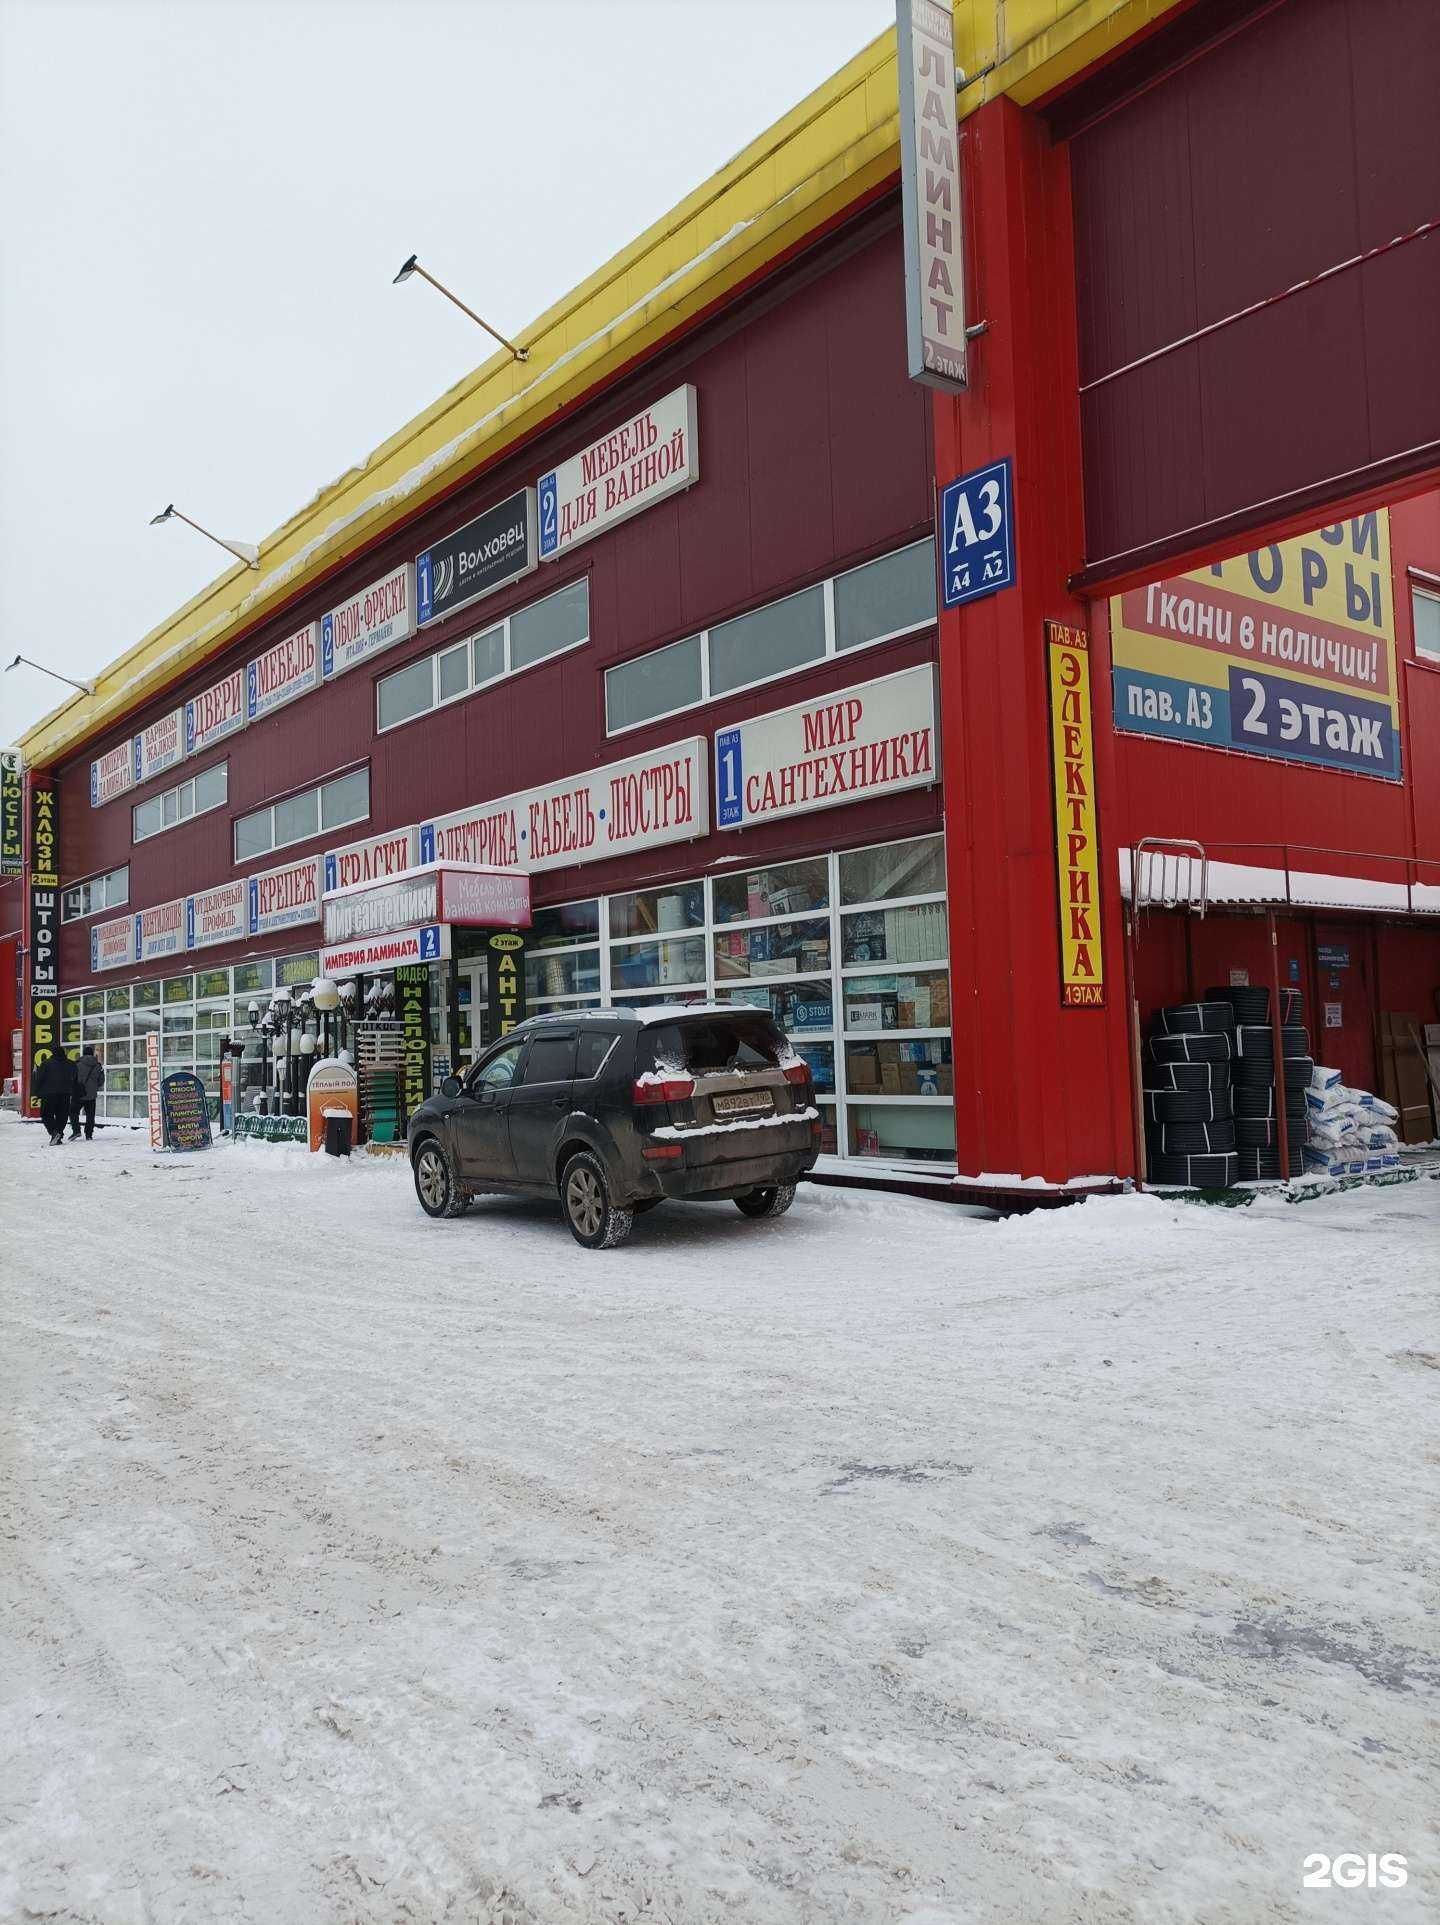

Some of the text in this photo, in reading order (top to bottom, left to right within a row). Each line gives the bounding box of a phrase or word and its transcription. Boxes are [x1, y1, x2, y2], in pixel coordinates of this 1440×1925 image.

[918, 44, 955, 337] ЛАМИНАТ
[924, 340, 966, 382] 2 ЭТАЖ
[580, 414, 658, 488] МЕБЕЛЬ
[560, 427, 685, 547] ДЛЯ ВАННОЙ
[543, 490, 555, 536] 2
[948, 480, 1002, 554] А3
[458, 521, 525, 575] Волховец
[420, 567, 430, 606] 1
[951, 559, 1003, 593] А4 А2
[334, 572, 407, 650] ОБОИ ФРЕСКИ
[324, 626, 332, 661] 2
[1050, 623, 1088, 649] ПАВ. А3
[1146, 581, 1378, 684] Ткани в наличии!
[257, 628, 315, 698] МЕБЕЛЬ
[250, 673, 256, 704] 2
[1127, 683, 1213, 730] пав. А3
[187, 712, 193, 740] 2
[194, 671, 241, 746] ДВЕРИ
[801, 698, 863, 754] МИР
[1241, 677, 1385, 760] 2 этаж
[145, 711, 178, 747] КАРНИЗЫ
[136, 747, 141, 770] 2
[146, 733, 178, 763] ЖАЛЮЗИ
[722, 750, 738, 802] 1
[746, 728, 932, 814] САНТЕХНИКИ
[2, 772, 21, 855] ЛЮСТРЫ
[437, 757, 693, 868] ЭЛЕКТРИКА КАБЕЛЬ ЛЮСТРЫ
[721, 807, 740, 820] ЭТАЖ
[1059, 652, 1096, 977] ЭЛЕКТРИКА
[35, 791, 54, 871] ЖАЛЮЗИ
[339, 837, 408, 888] КРАСКИ
[423, 838, 431, 864] 1
[33, 874, 39, 884] 2
[259, 863, 317, 915] КРЕПЕЖ
[327, 866, 335, 890] 1
[459, 875, 513, 899] Мебель для
[194, 884, 243, 916] ОТДЕЛОЧНЫЙ
[251, 889, 258, 922] 1
[485, 895, 530, 913] комнаты
[35, 892, 54, 980] ШТОРЫ
[136, 919, 142, 950] 1
[188, 908, 194, 937] 1
[202, 909, 236, 933] ПРОФИЛЬ
[325, 939, 419, 970] ИМПЕРИЯ ЛАМИНАТА
[426, 929, 435, 951] 2
[32, 986, 39, 995] 2
[396, 967, 428, 983] ВИДЕО
[808, 1005, 831, 1017] STOUT
[1065, 985, 1103, 1003] 1 ЭТАЖ
